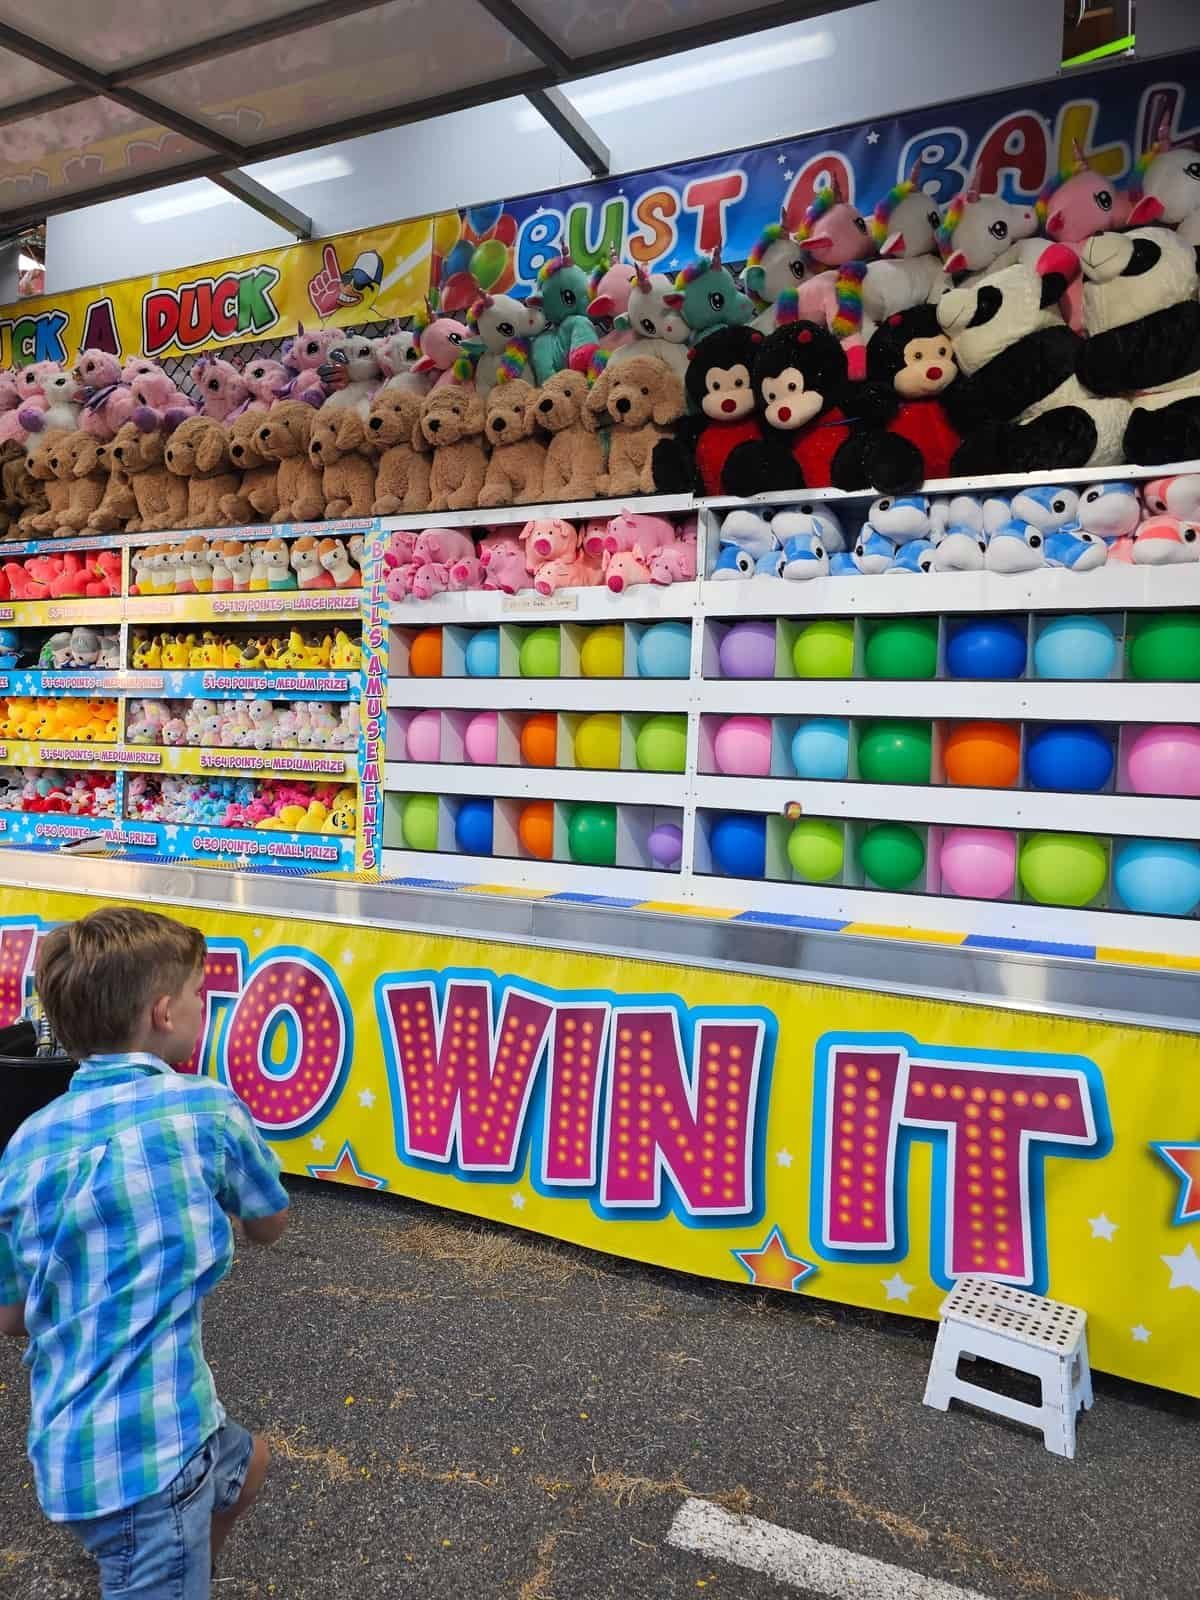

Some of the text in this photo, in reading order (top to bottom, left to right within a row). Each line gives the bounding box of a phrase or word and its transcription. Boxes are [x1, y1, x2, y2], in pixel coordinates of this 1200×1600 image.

[515, 169, 748, 285] BUST
[81, 297, 122, 357] A
[142, 264, 280, 357] DUCK
[246, 599, 282, 611] POINTS
[292, 598, 325, 610] LARGE
[326, 596, 359, 609] PRIZE
[203, 677, 232, 689] 31-64
[232, 678, 267, 690] POINTS
[275, 677, 316, 690] MEDIUM
[316, 678, 347, 691] PRIZE
[361, 541, 385, 869] BILLS AMUSEMENTS
[40, 749, 64, 760] 31-64
[64, 750, 93, 761] POINTS
[101, 750, 135, 763] MEDIUM
[135, 752, 161, 764] PRIZE
[200, 755, 229, 768] 31-64
[229, 756, 263, 769] POINTS
[272, 757, 312, 771] MEDIUM
[312, 759, 345, 773] PRIZE
[35, 824, 58, 837] 0-30
[128, 831, 157, 845] PRIZE
[193, 836, 219, 850] 0-30
[219, 838, 258, 854] POINTS
[267, 842, 303, 857] SMALL
[303, 845, 337, 860] PRIZE
[383, 980, 766, 1216] WIN
[822, 1045, 1098, 1286] IT
